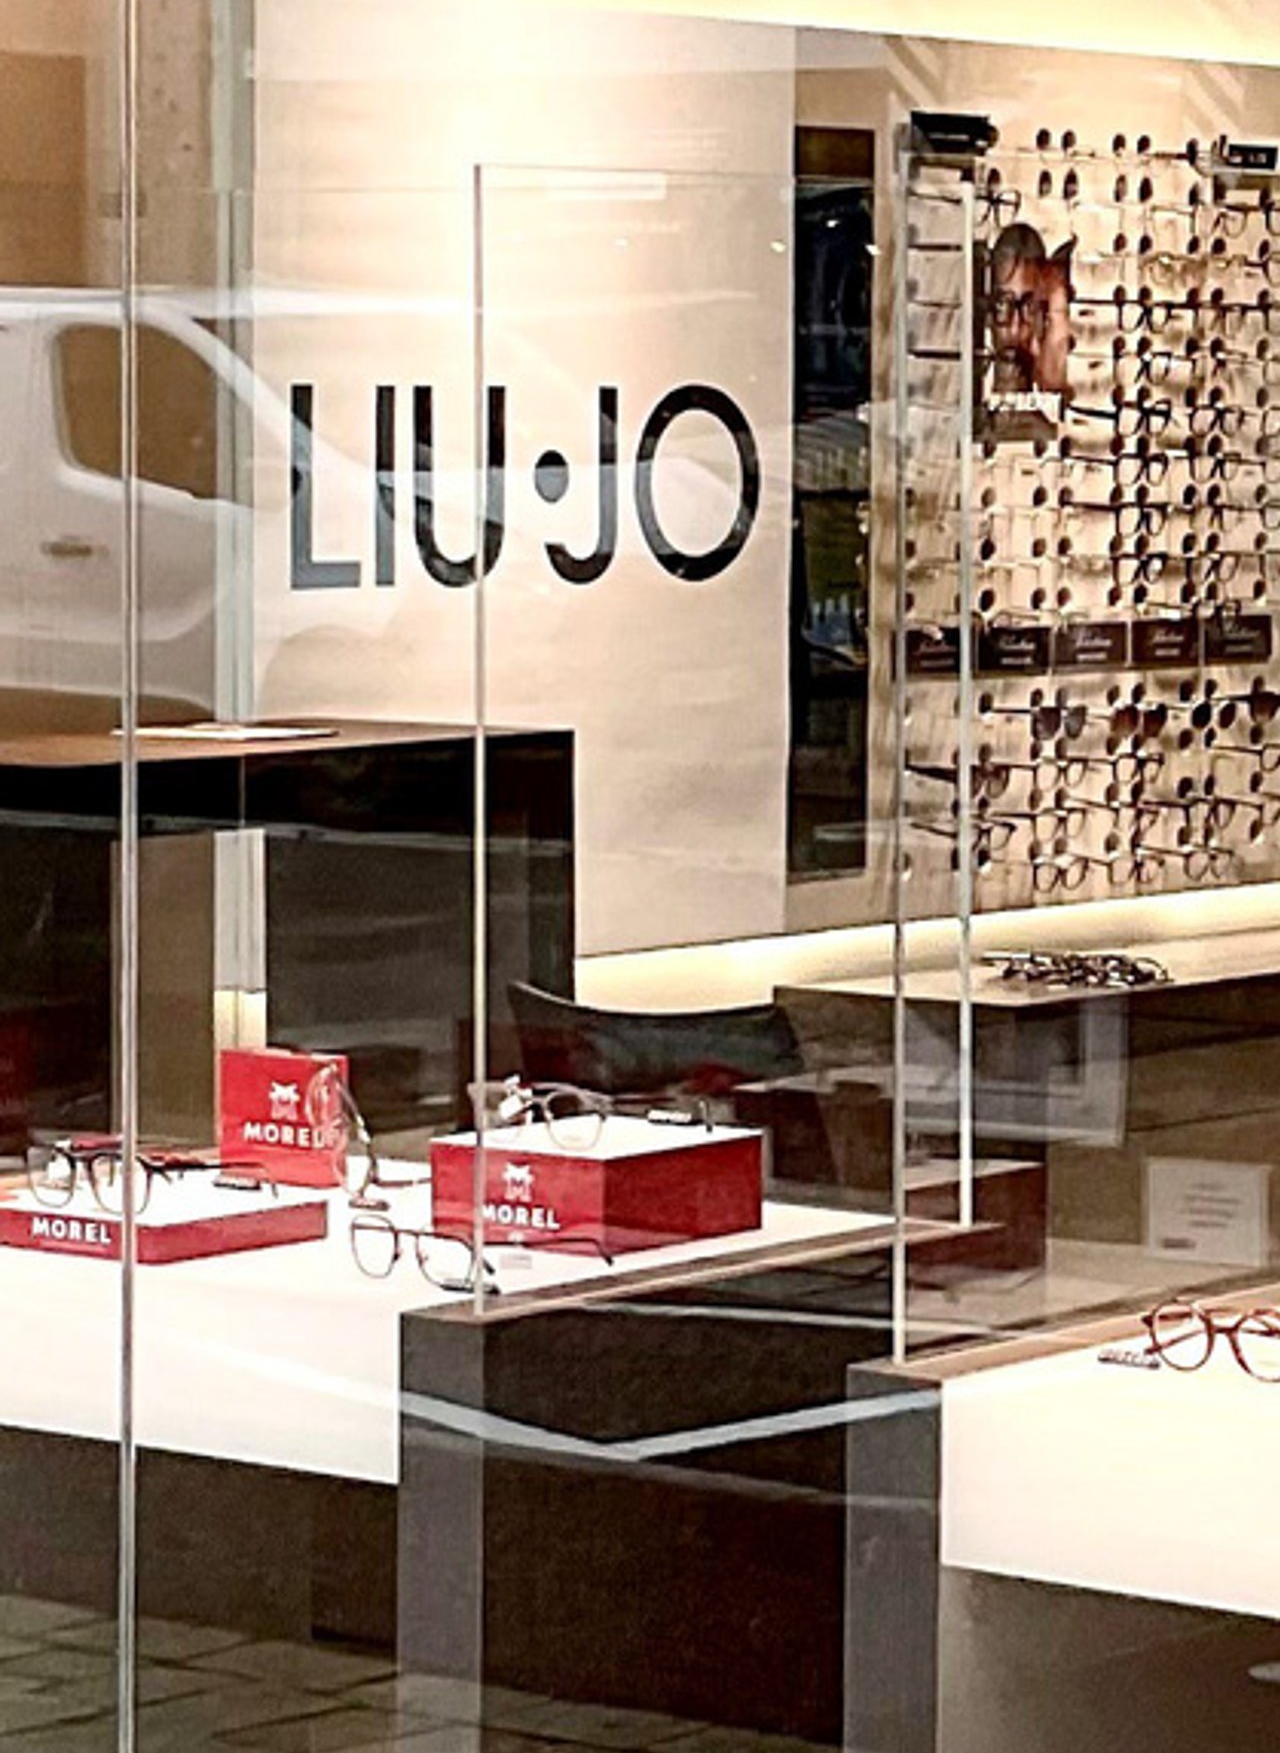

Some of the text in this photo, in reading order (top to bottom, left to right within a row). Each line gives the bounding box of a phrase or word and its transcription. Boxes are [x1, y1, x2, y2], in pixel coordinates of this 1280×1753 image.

[243, 1120, 326, 1149] MOREL
[31, 1216, 112, 1245] MOREL
[482, 1203, 561, 1230] MOREL
